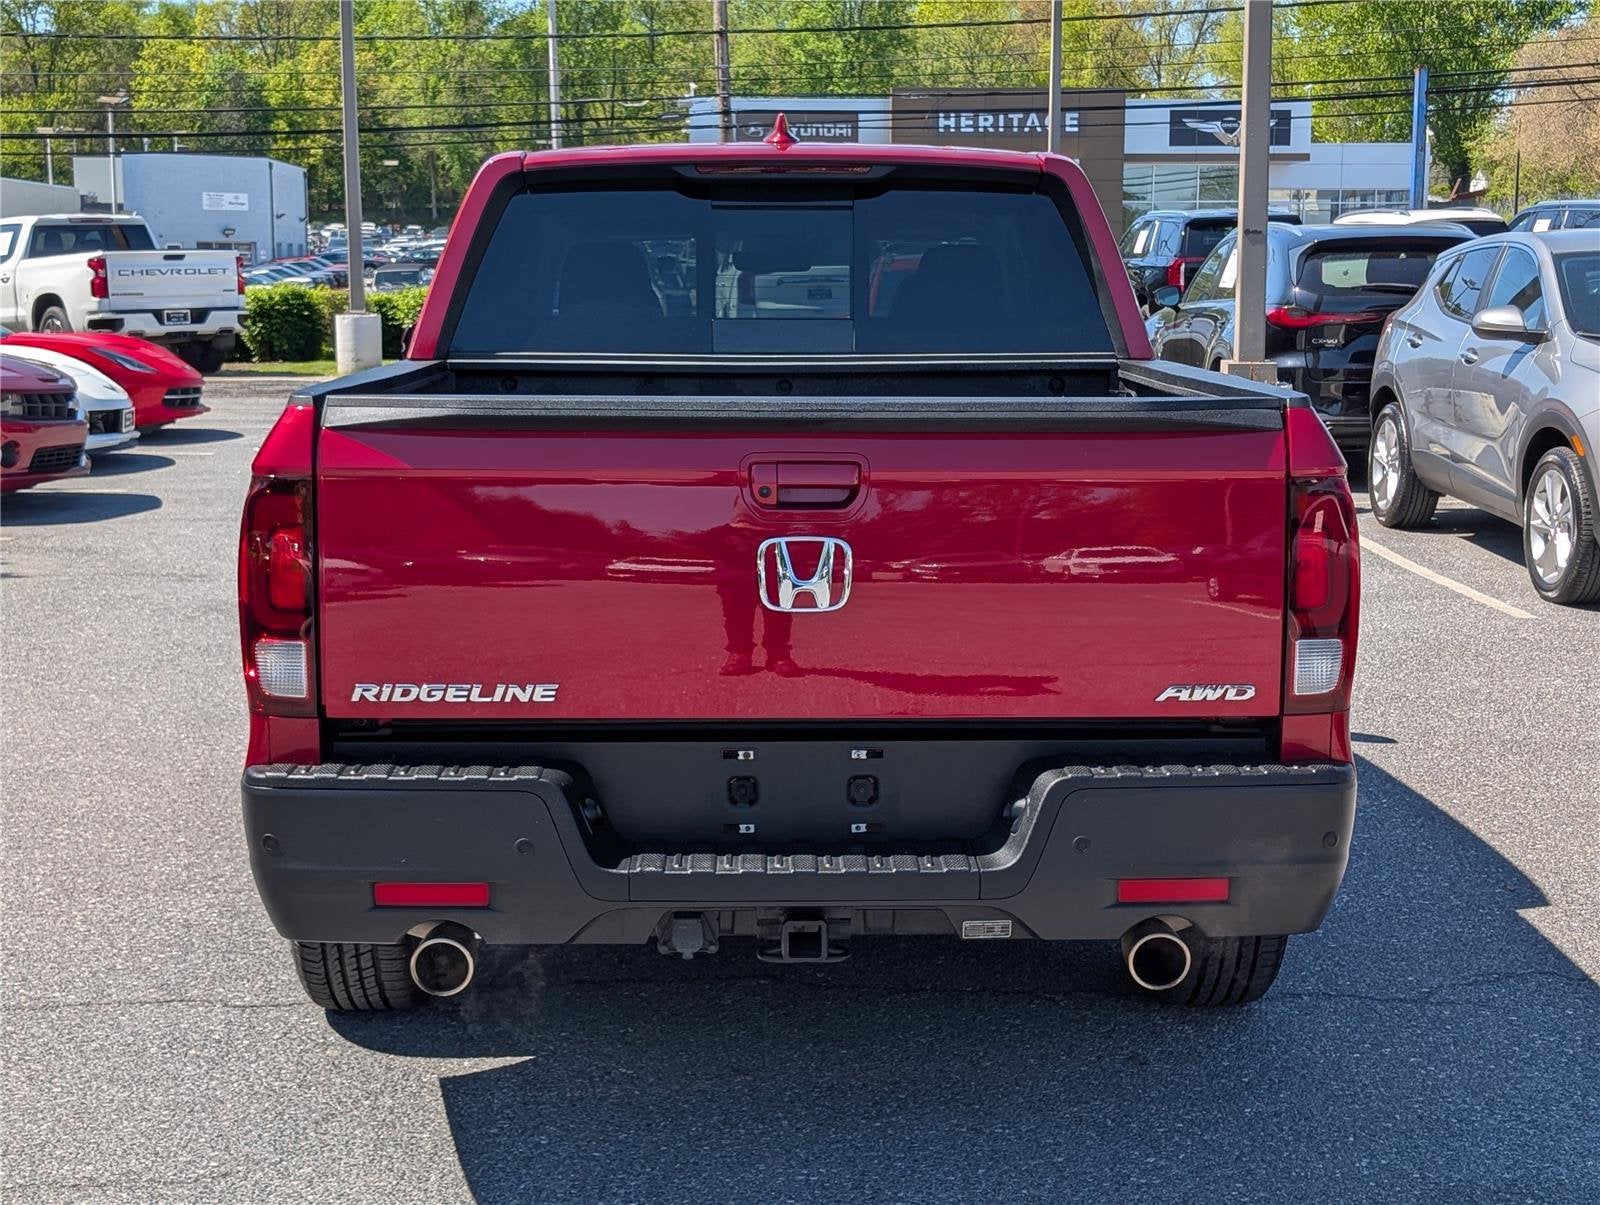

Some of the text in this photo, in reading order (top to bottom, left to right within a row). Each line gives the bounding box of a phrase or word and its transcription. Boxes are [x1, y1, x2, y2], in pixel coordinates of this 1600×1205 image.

[788, 124, 852, 137] YUNDAI
[118, 267, 229, 277] CHEVROLET
[350, 683, 560, 703] RIDGELINE
[1154, 684, 1256, 702] AWD
